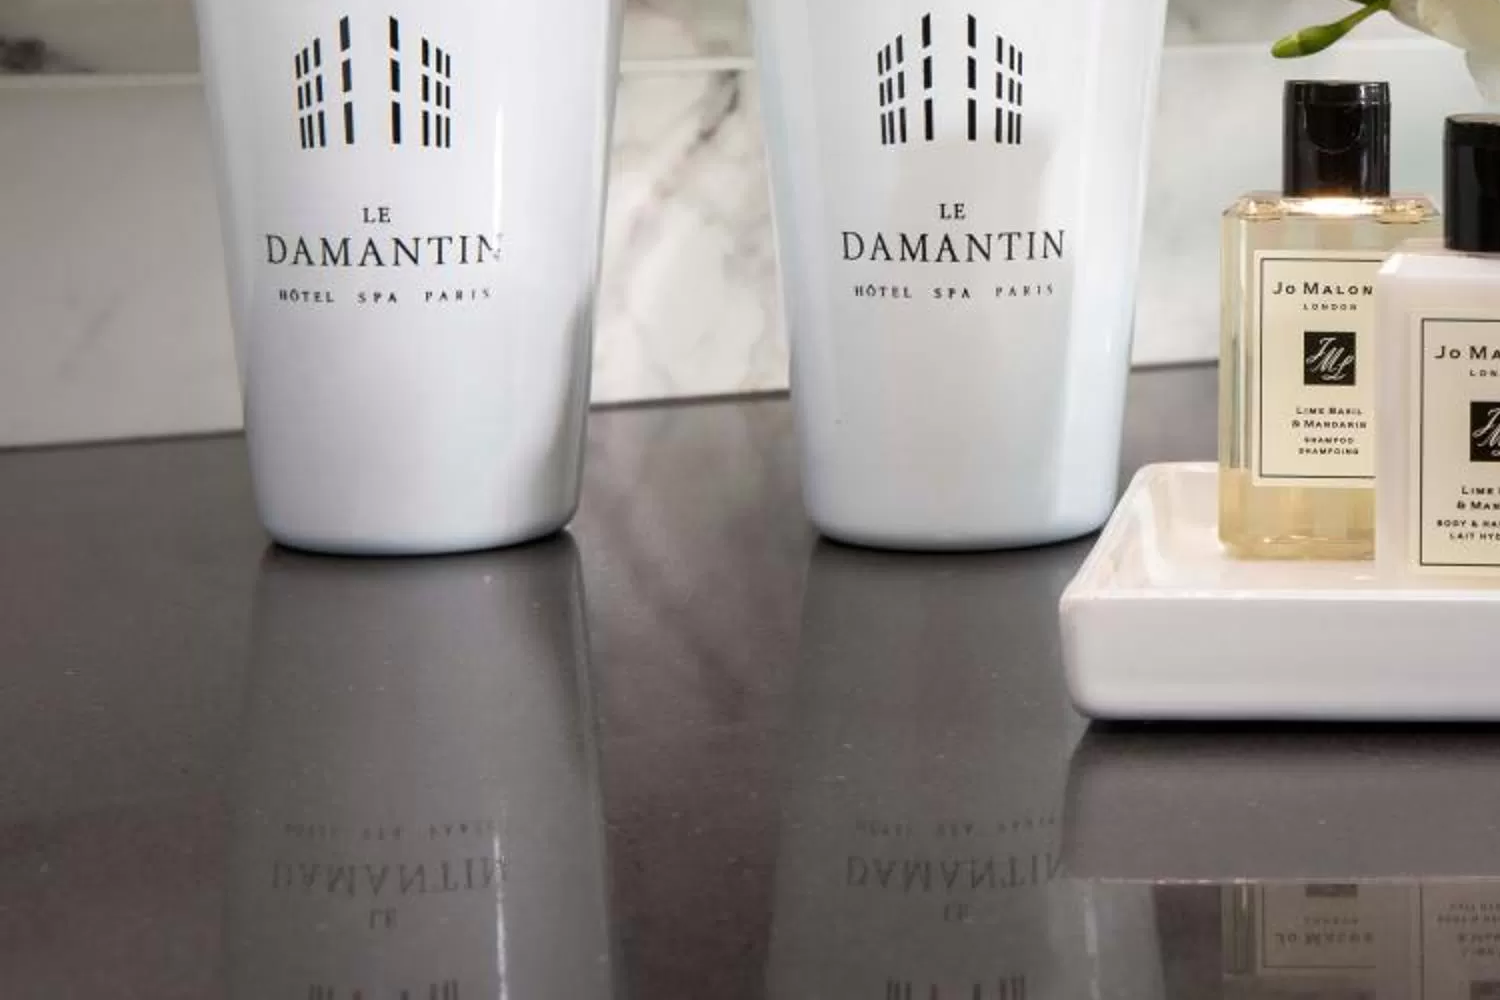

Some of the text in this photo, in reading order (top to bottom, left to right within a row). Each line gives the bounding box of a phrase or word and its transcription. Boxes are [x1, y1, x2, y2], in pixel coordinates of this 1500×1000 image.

[363, 208, 391, 223] LE
[939, 203, 966, 219] LE
[266, 233, 503, 267] DAMANTIN
[841, 229, 1065, 262] DAMANTIN
[357, 292, 397, 303] SPA
[425, 288, 491, 302] PARIS
[933, 287, 970, 299] SPA
[996, 284, 1053, 297] PARIS
[1272, 281, 1373, 296] JO MALON
[1303, 303, 1358, 311] LONDON
[1434, 345, 1460, 360] JO
[1296, 406, 1363, 416] LIME BASIL
[1292, 420, 1367, 429] & MANDARIN
[1461, 486, 1494, 496] LIME
[1456, 501, 1466, 510] &
[1437, 519, 1467, 528] BODY
[1471, 520, 1479, 528] &
[1450, 533, 1475, 541] LAIT
